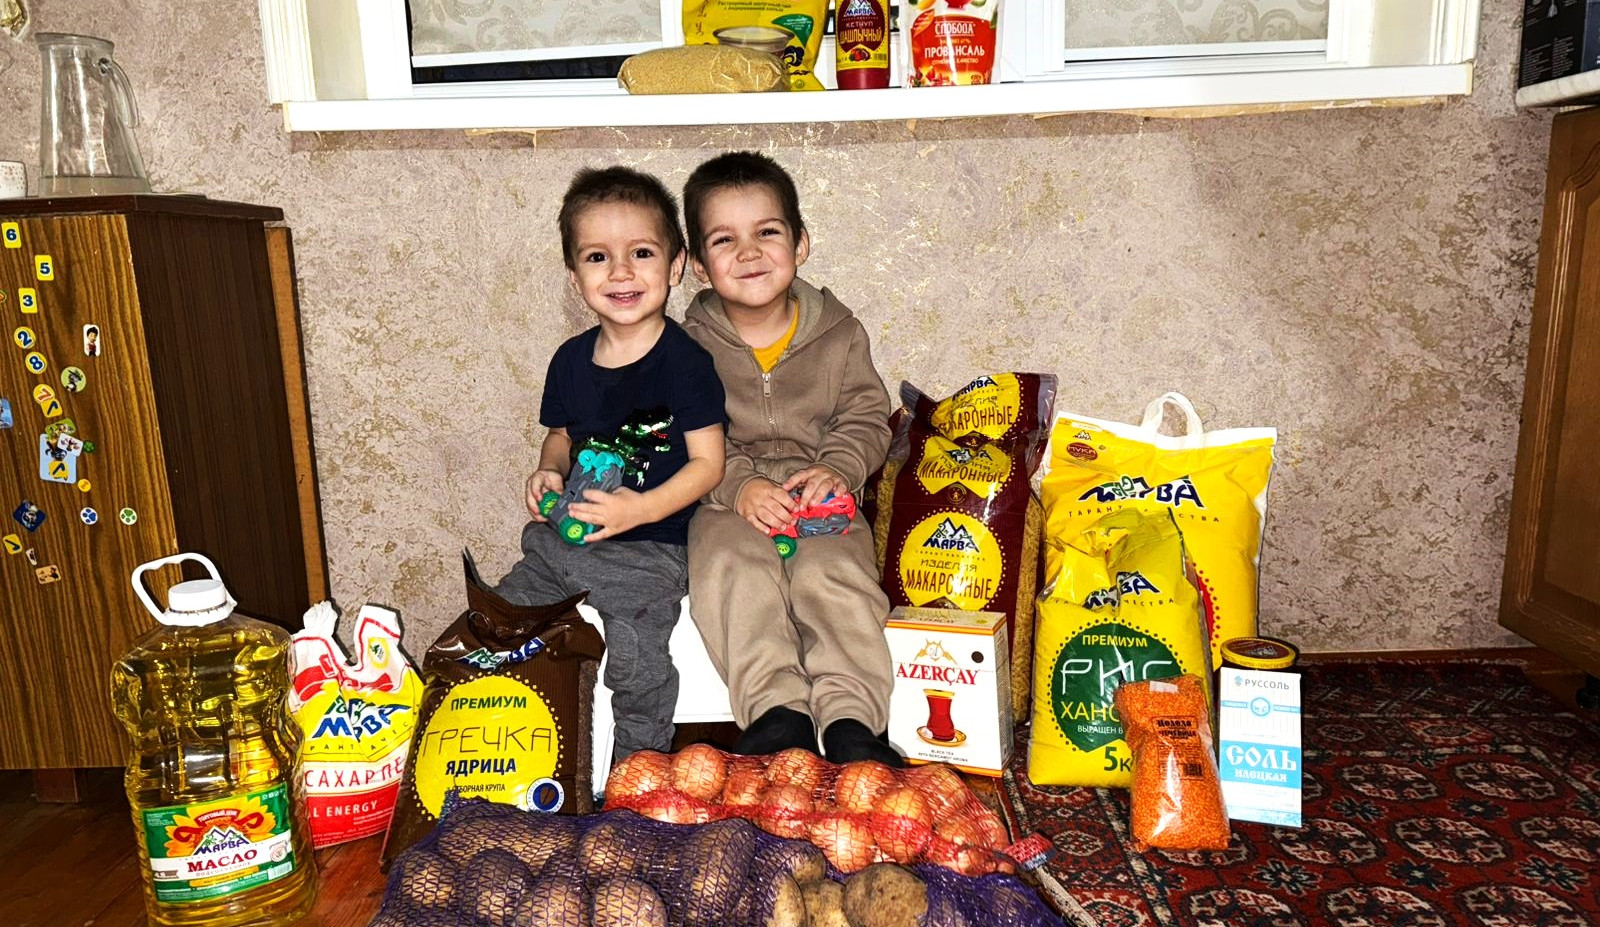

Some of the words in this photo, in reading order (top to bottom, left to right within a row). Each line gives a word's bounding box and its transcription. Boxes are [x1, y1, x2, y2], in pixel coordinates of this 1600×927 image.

[935, 22, 974, 35] СЛОБОДА
[924, 45, 985, 59] ПРОВНСАЛЬ
[6, 229, 17, 241] 6
[40, 262, 51, 274] 5
[22, 294, 34, 307] 3
[17, 331, 33, 346] 2
[29, 356, 44, 371] 8
[904, 568, 992, 600] МАКАРОНЫЕ
[1082, 634, 1149, 648] ПРЕМИУМ
[896, 663, 978, 686] AZERÇAY
[1245, 678, 1290, 690] РУССОЛЬ
[451, 696, 527, 711] ПРЕМИУМ
[1077, 725, 1117, 735] ВЫРАЩЕН
[422, 725, 552, 758] ГРЕЧКА
[1225, 744, 1297, 771] СОЛЬ
[446, 758, 517, 777] ЯДРИЦА
[304, 769, 376, 788] САХАР
[1234, 768, 1287, 783] ИЛЕЦКАЯ
[326, 800, 378, 817] ENERGY
[193, 838, 250, 856] МАРВА
[187, 849, 258, 873] МАСЛО
